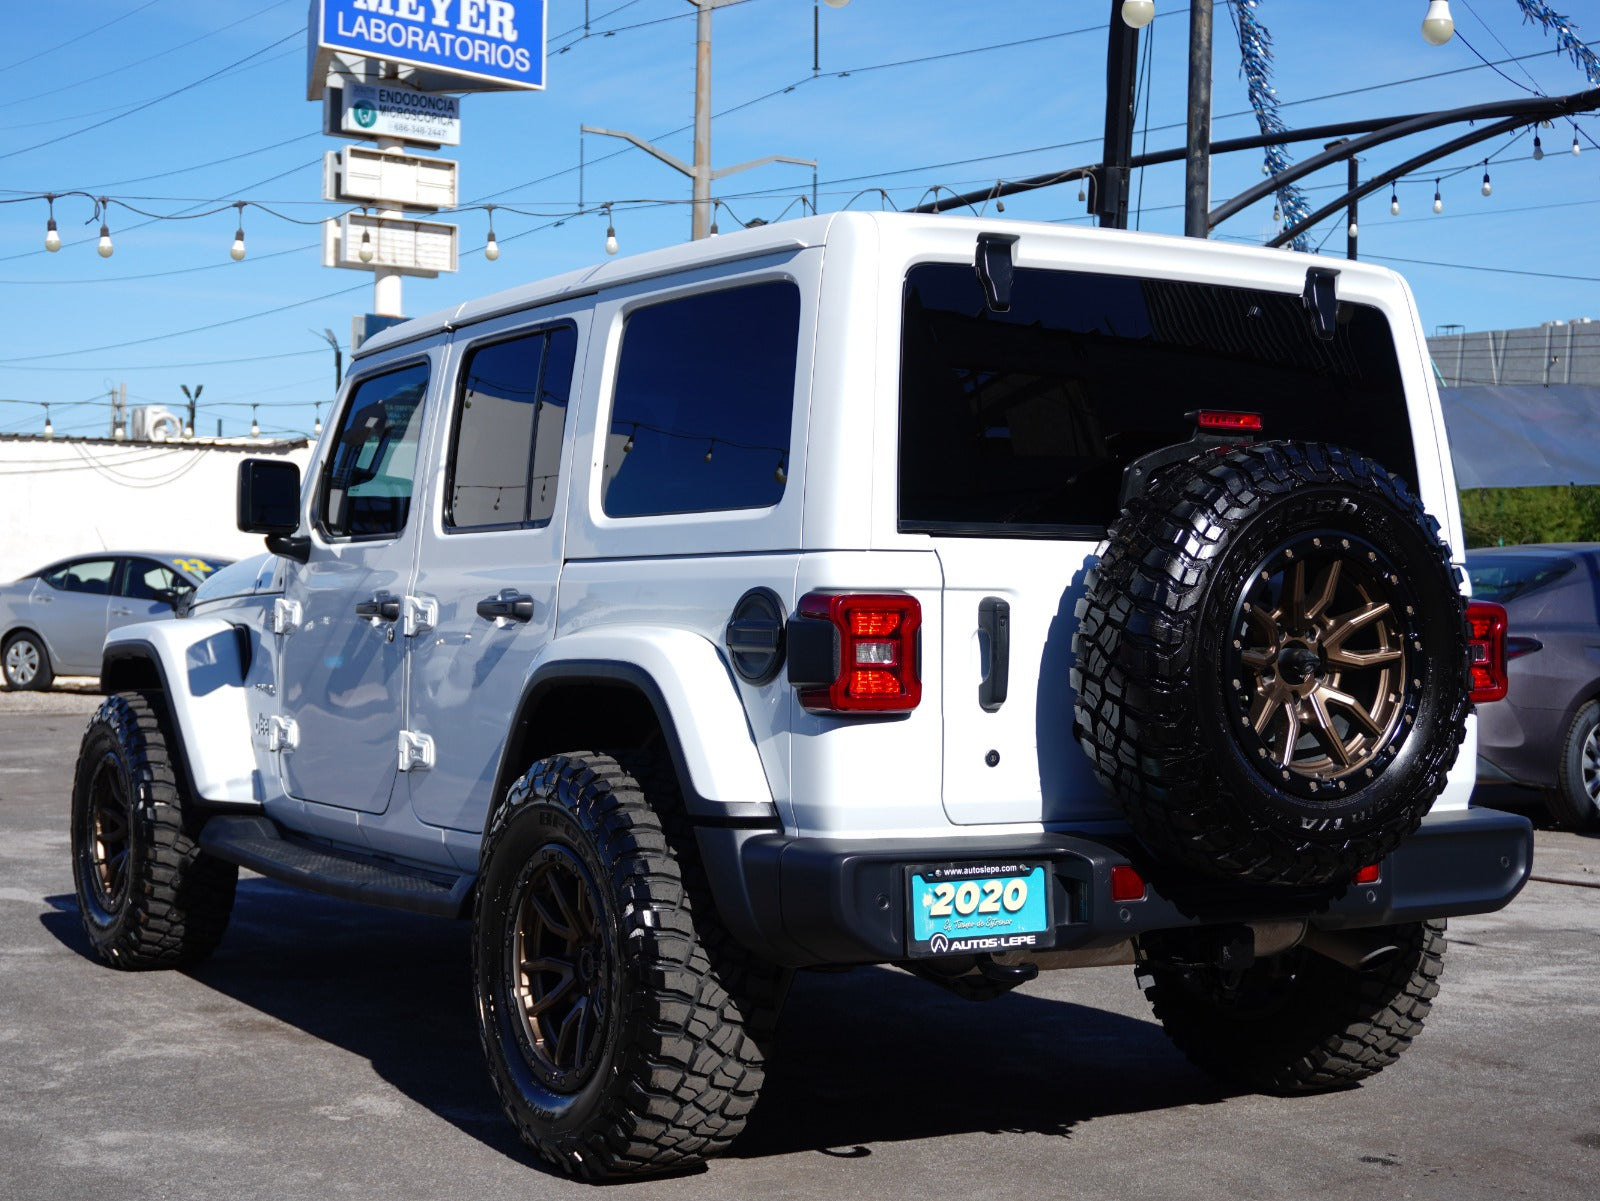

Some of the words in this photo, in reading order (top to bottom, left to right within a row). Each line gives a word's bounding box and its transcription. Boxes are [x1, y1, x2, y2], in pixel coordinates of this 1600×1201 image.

[337, 11, 532, 73] LABORATORIOS
[378, 88, 455, 113] ENDODONCIA
[378, 104, 455, 127] MICROSCOPICA
[255, 712, 271, 738] Jee
[943, 864, 1018, 877] www.autoslepe.com
[930, 878, 1029, 917] 2020
